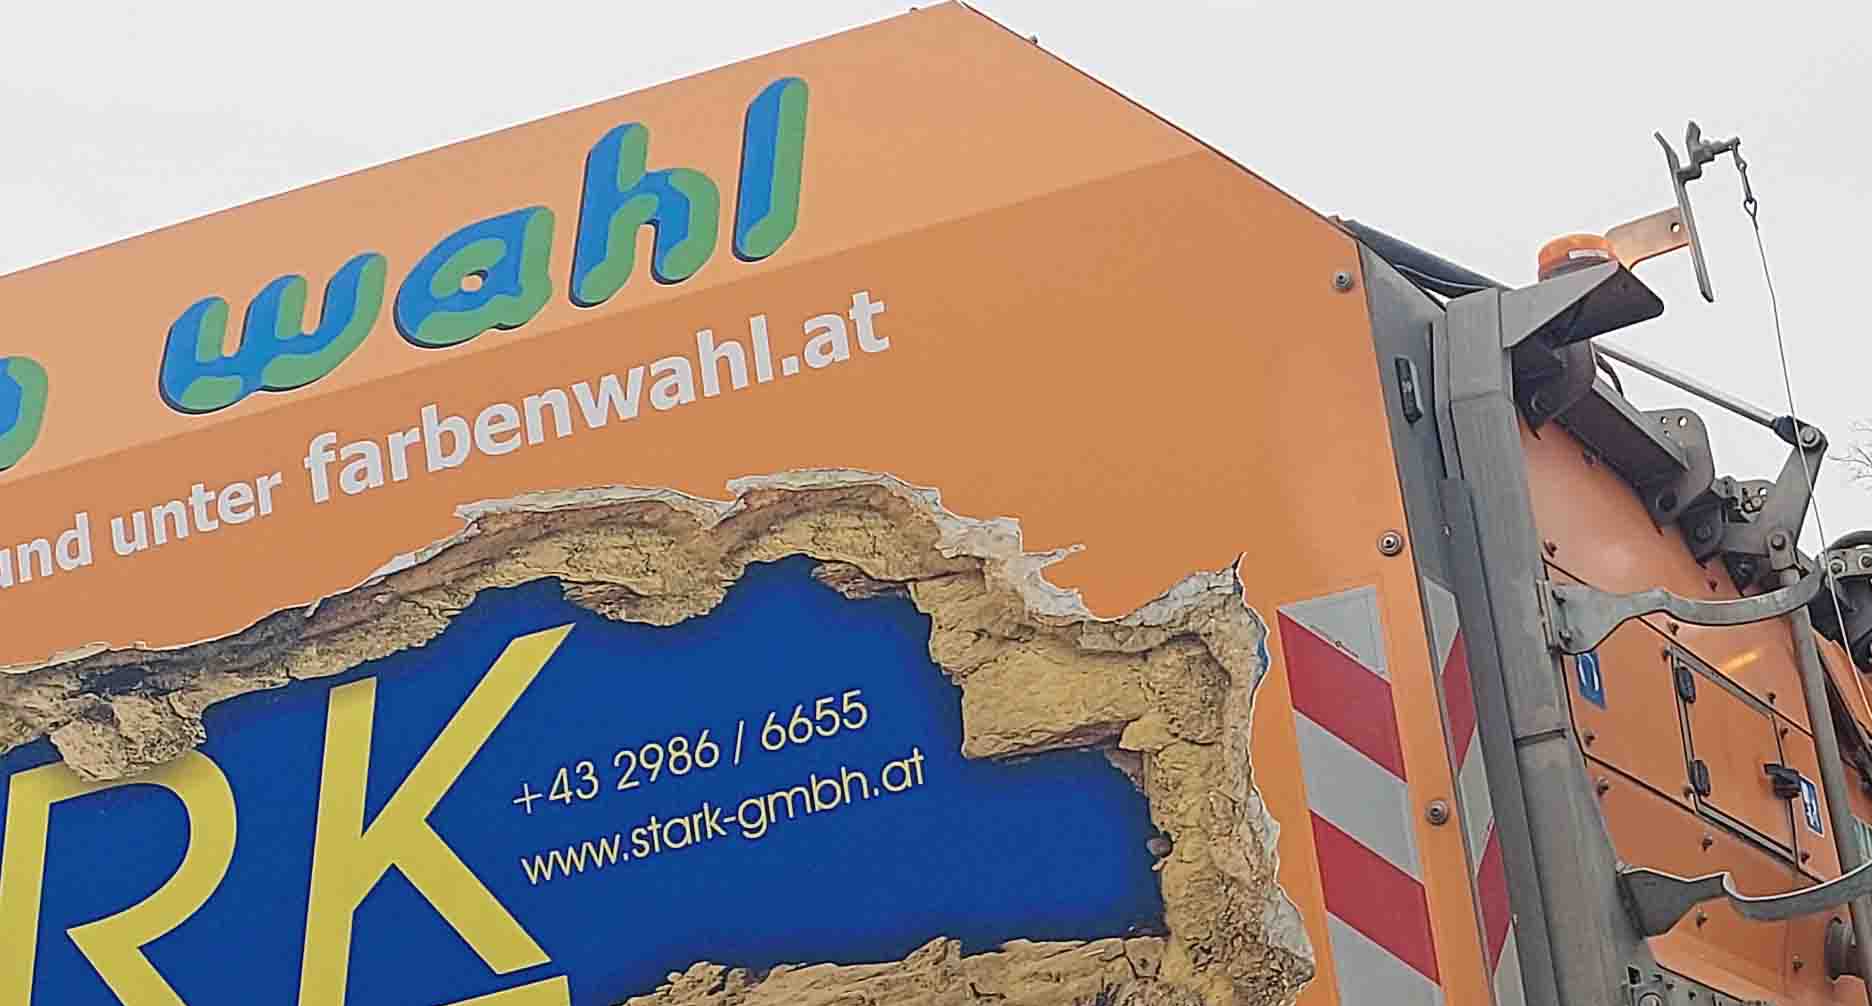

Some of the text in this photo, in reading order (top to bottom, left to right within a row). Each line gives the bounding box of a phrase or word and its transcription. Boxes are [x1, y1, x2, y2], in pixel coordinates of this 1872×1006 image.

[158, 76, 810, 415] wahl
[110, 470, 283, 556] unter
[303, 290, 890, 505] farbenwahl.at
[512, 689, 869, 815] +43 2986 / 6655
[520, 746, 926, 886] www.stark-gmbh.at
